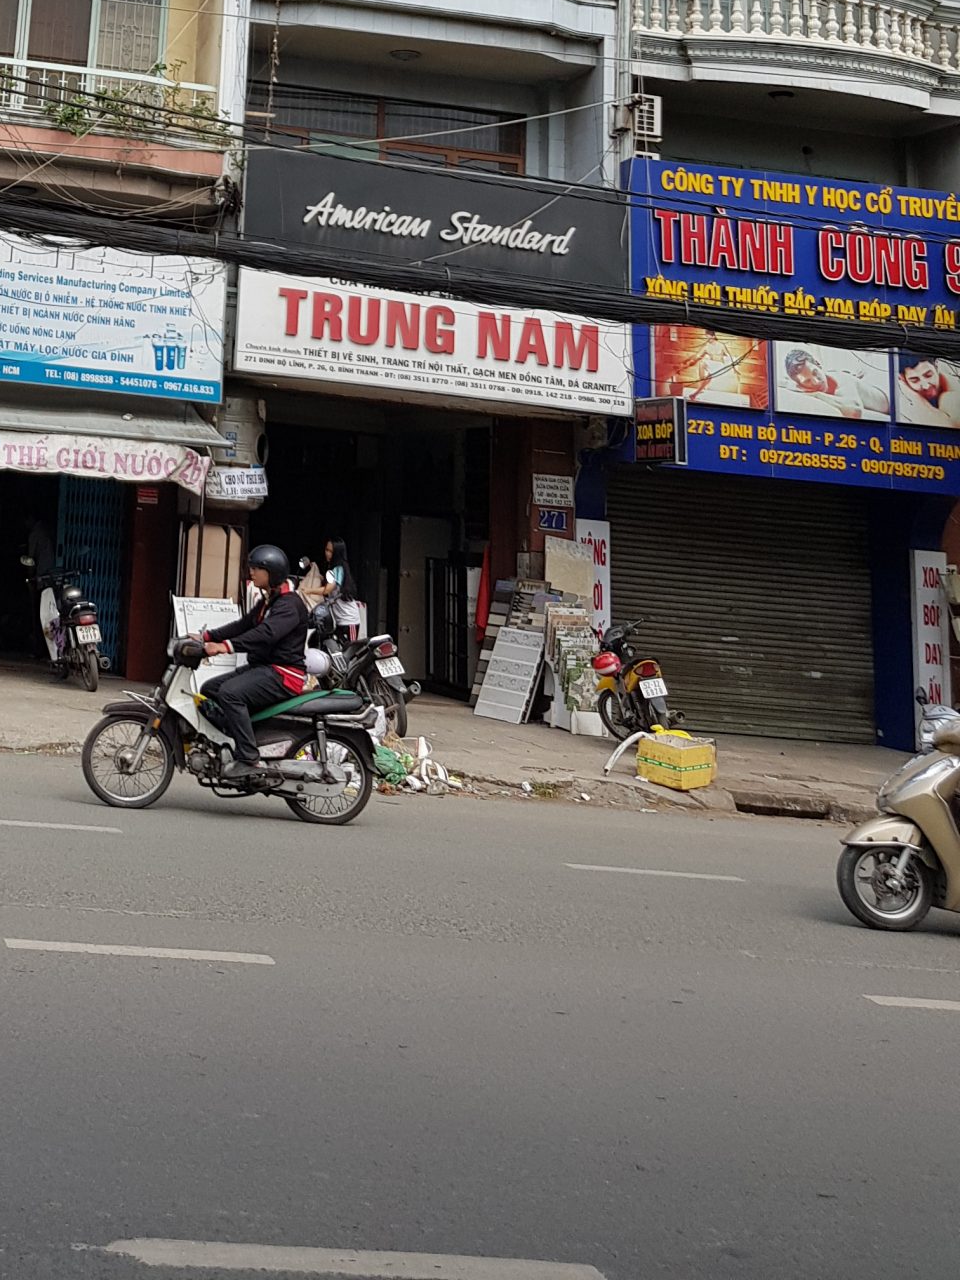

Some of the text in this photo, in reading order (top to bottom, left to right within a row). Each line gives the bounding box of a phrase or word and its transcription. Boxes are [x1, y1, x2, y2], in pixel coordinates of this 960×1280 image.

[661, 166, 715, 195] CÔNG
[718, 175, 745, 198] TY
[750, 179, 801, 204] TNHH
[805, 184, 819, 206] Y
[822, 186, 862, 213] HỌC
[865, 186, 894, 215] CỔ
[303, 191, 577, 255] American Standard
[654, 206, 795, 276] THÀNH
[818, 220, 930, 290] CÔNG
[18, 270, 53, 284] Services
[56, 275, 117, 293] Manufacturing
[119, 281, 157, 297] Company
[160, 286, 192, 299] Limited
[34, 290, 43, 302] BỊ
[645, 274, 689, 303] XÔNG
[693, 281, 722, 308] HƠI
[725, 285, 780, 313] THUỐC
[784, 286, 816, 317] BẮC
[22, 306, 31, 318] BỊ
[62, 309, 84, 322] NƯỚC
[278, 287, 600, 374] TRUNG NAM
[14, 339, 36, 352] MÁY
[39, 344, 58, 356] LỌC
[61, 345, 88, 359] NƯỚC
[91, 350, 107, 361] GIA
[110, 350, 134, 364] ĐÌNH
[244, 355, 257, 363] 271
[303, 346, 329, 359] THIẾT
[331, 351, 340, 362] BỊ
[342, 350, 354, 361] VỆ
[356, 354, 379, 365] SINH,
[381, 357, 410, 368] TRANG
[412, 359, 426, 369] TRÍ
[428, 361, 443, 372] NỘI
[445, 362, 471, 376] THẤT,
[473, 368, 496, 379] GẠCH
[498, 371, 517, 381] MEN
[520, 371, 543, 384] ĐỒNG
[545, 375, 566, 387] TÂM,
[568, 377, 580, 389] ĐÁ
[3, 365, 20, 376] HCM
[45, 368, 62, 379] TEL:
[63, 371, 79, 381] (08)
[637, 420, 674, 440] XOA BÓP
[688, 419, 715, 436] 273
[721, 422, 753, 439] ĐINH
[757, 422, 778, 444] BỘ
[781, 426, 812, 445] LĨNH
[869, 437, 884, 454] Q.
[890, 435, 923, 456] BÌNH
[3, 435, 179, 477] THẾ GIỚI NƯỚC
[759, 448, 945, 480] 0972268555 0907987979
[540, 509, 567, 529] 271
